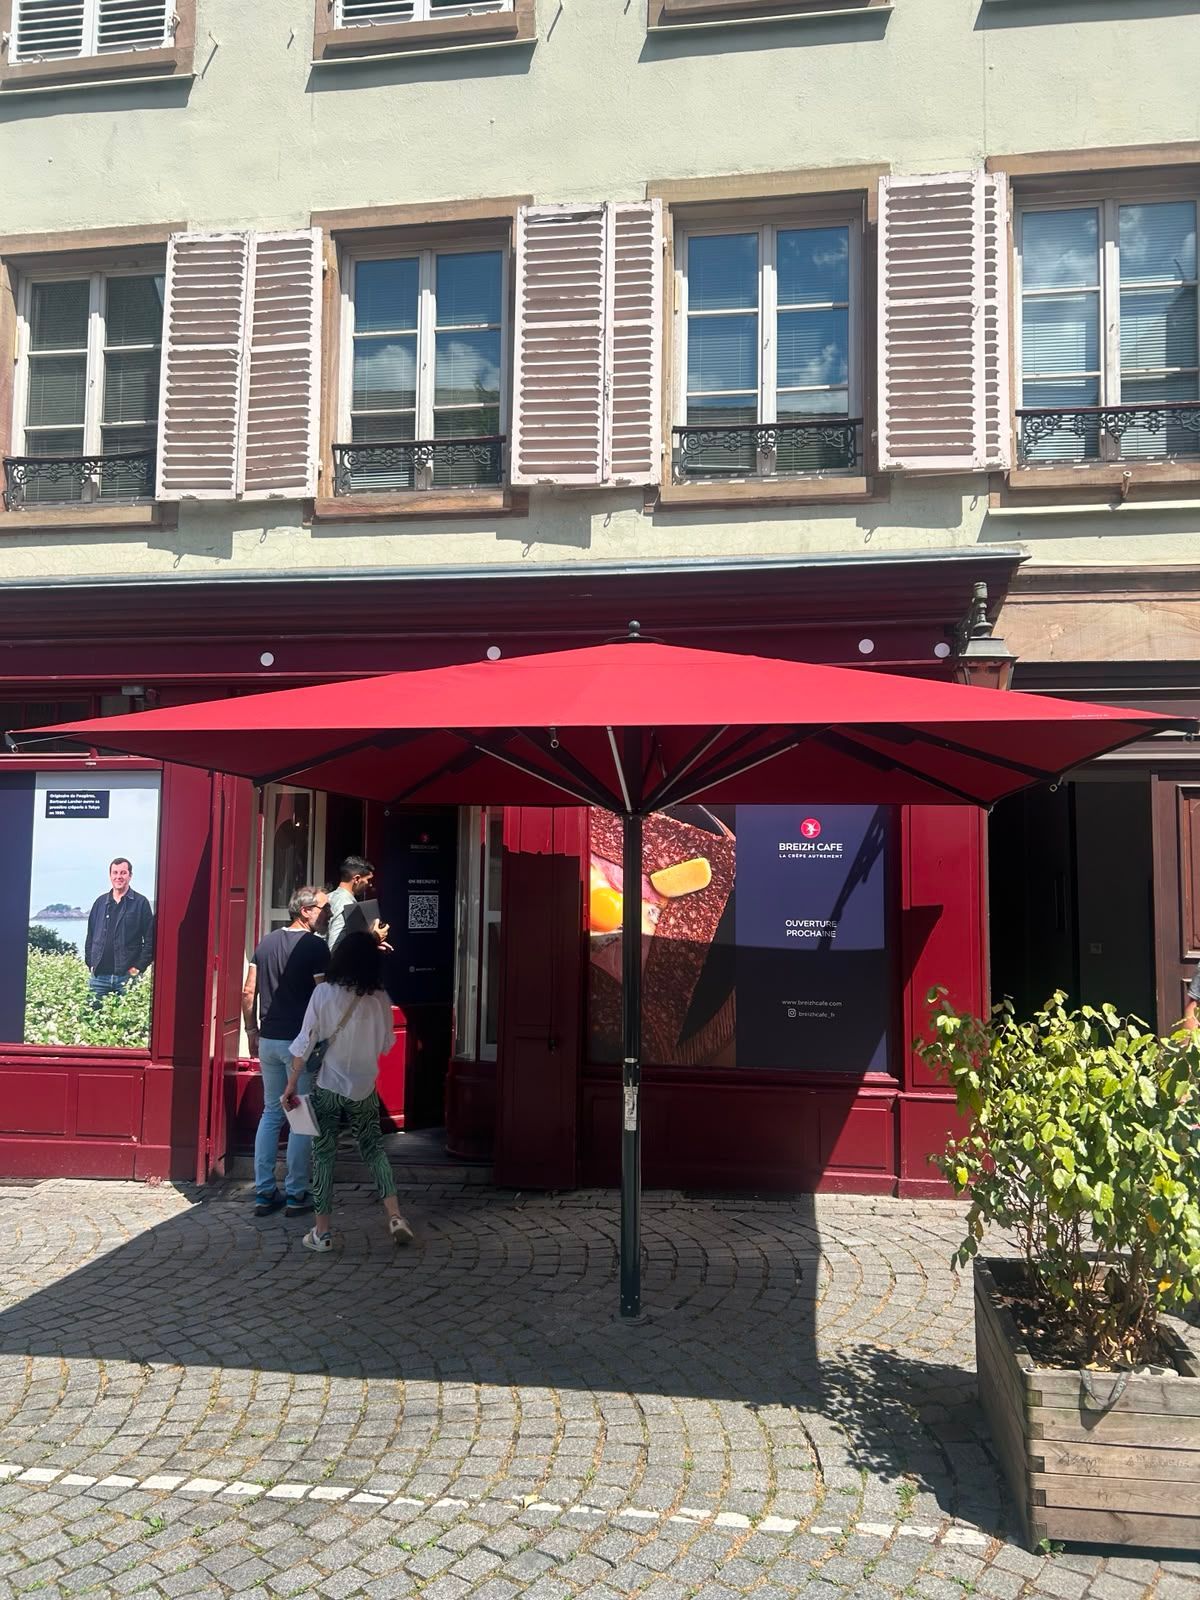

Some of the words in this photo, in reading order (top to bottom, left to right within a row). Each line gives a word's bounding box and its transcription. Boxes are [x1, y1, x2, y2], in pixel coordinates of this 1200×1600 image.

[779, 842, 815, 851] BREIZH
[816, 843, 843, 851] CAFE
[785, 919, 837, 928] OUVERTURE
[786, 929, 837, 938] PROCHAINE
[781, 999, 843, 1007] www.breizhcafe.com
